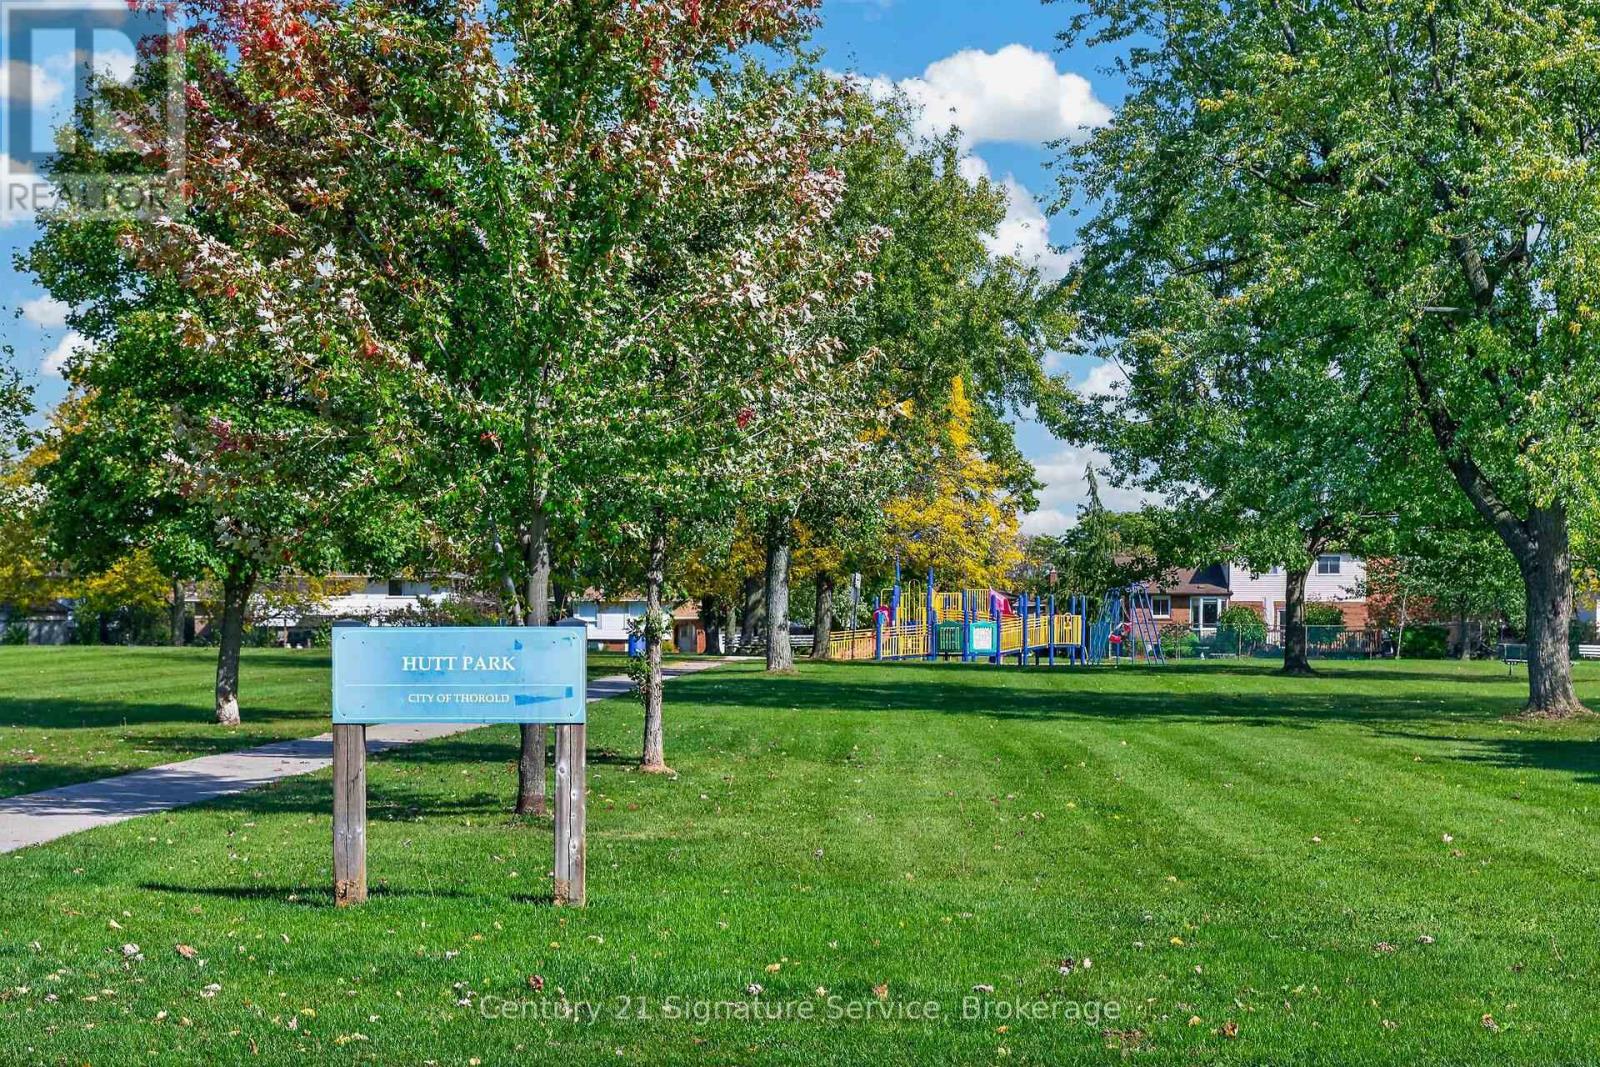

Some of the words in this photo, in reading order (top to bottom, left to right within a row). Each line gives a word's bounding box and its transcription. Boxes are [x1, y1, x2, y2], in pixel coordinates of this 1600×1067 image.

[402, 656, 457, 671] HUTT
[462, 656, 516, 671] PARK
[408, 693, 433, 704] CITY
[436, 693, 452, 704] OF
[453, 693, 509, 704] THOROLD
